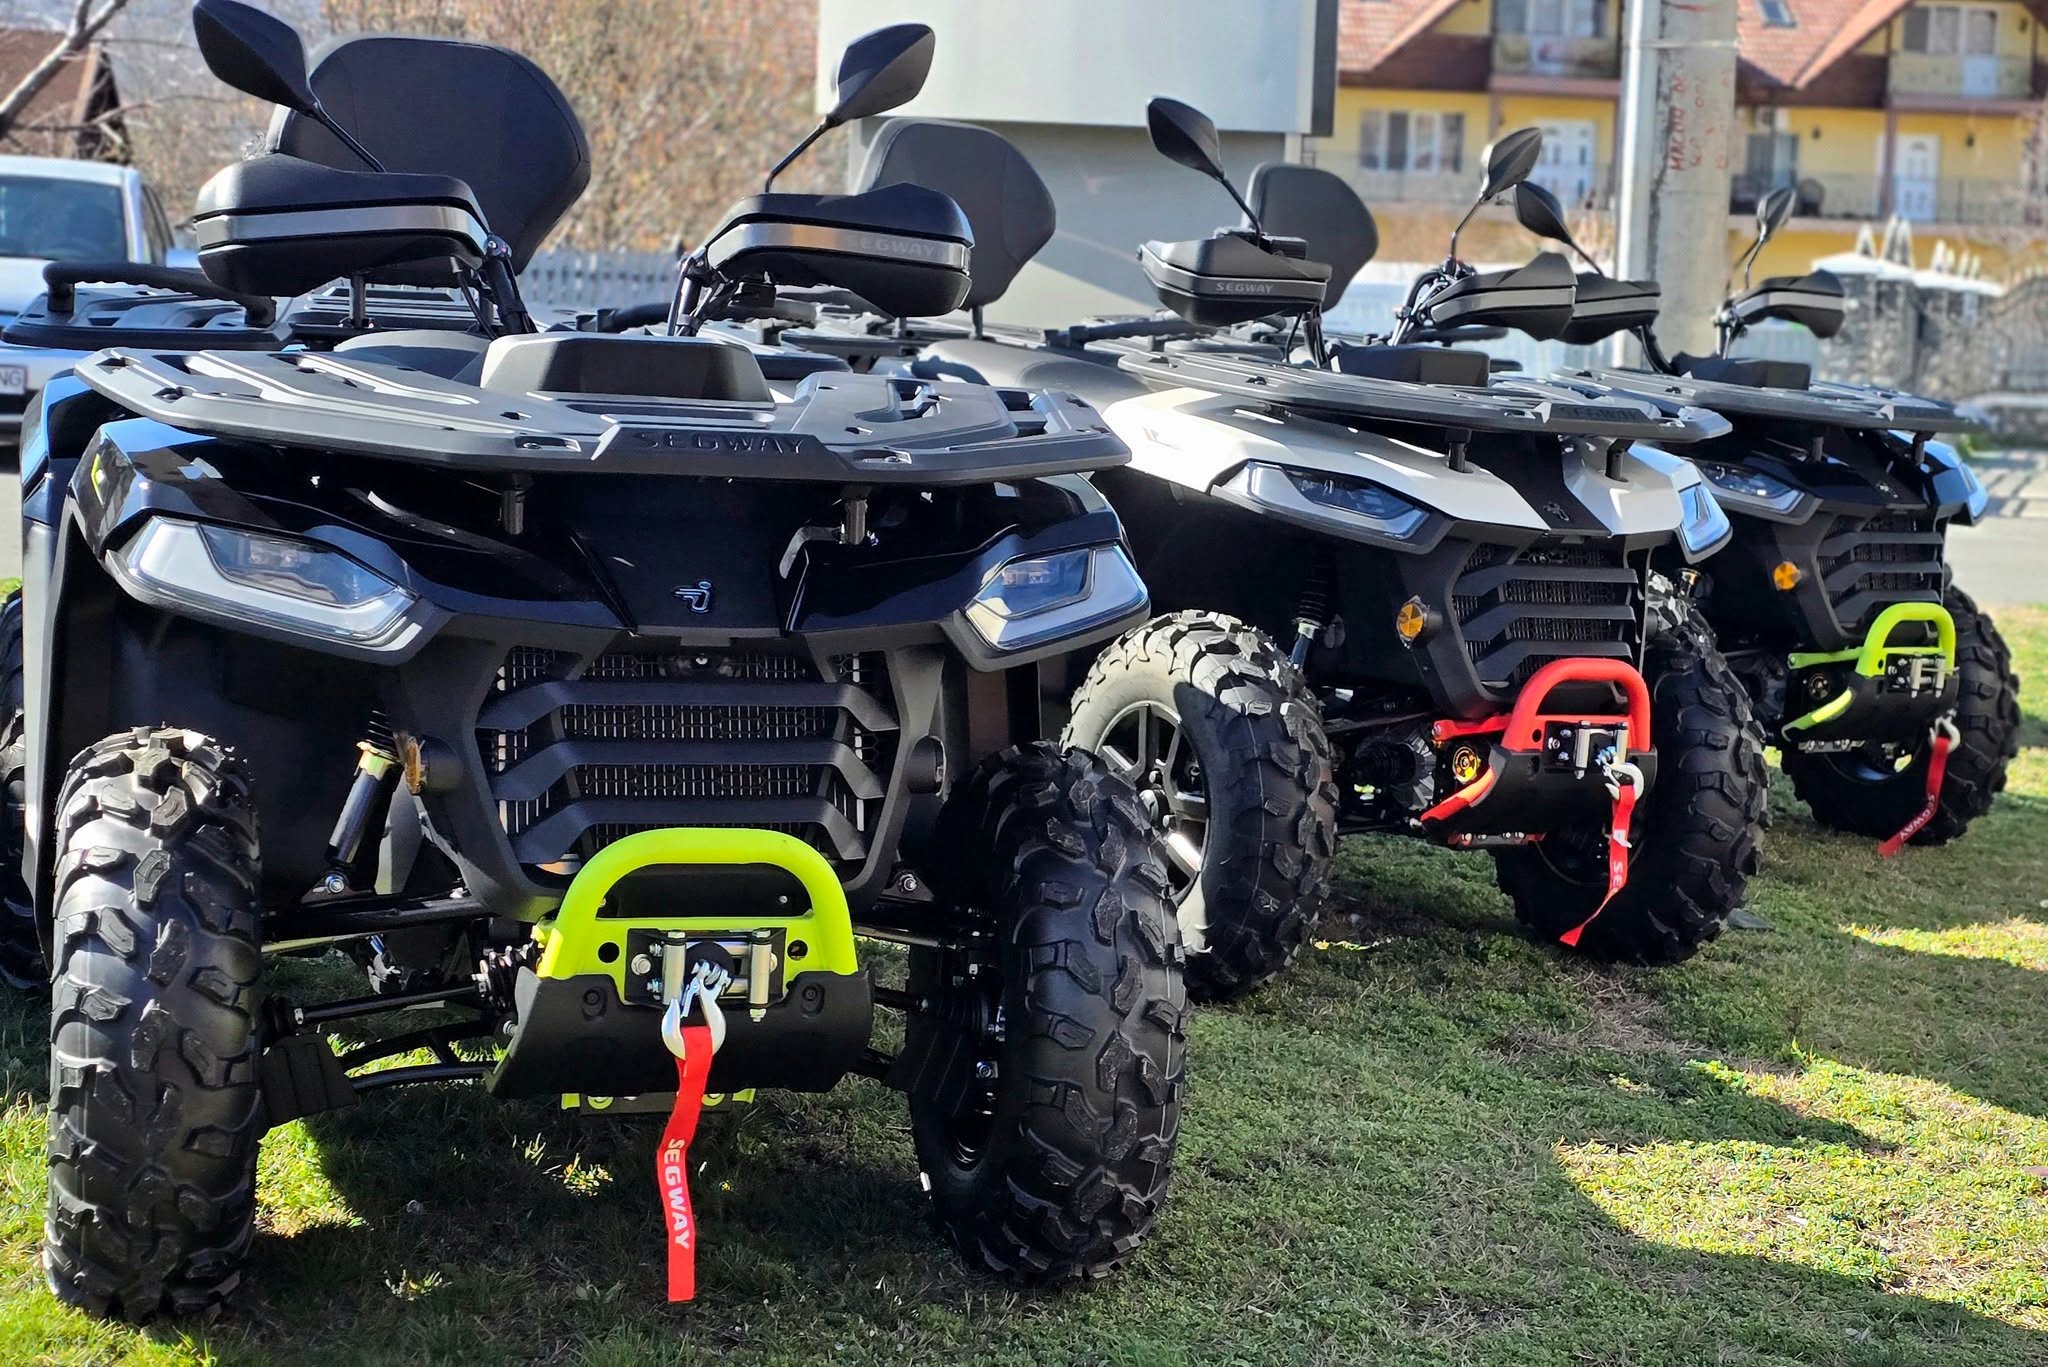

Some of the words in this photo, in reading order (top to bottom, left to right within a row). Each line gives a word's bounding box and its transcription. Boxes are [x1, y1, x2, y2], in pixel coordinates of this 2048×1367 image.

[1215, 282, 1273, 294] SEGWAY
[633, 432, 804, 454] SEGWAY
[1613, 860, 1624, 894] SE
[663, 1138, 690, 1249] SEGWAY
